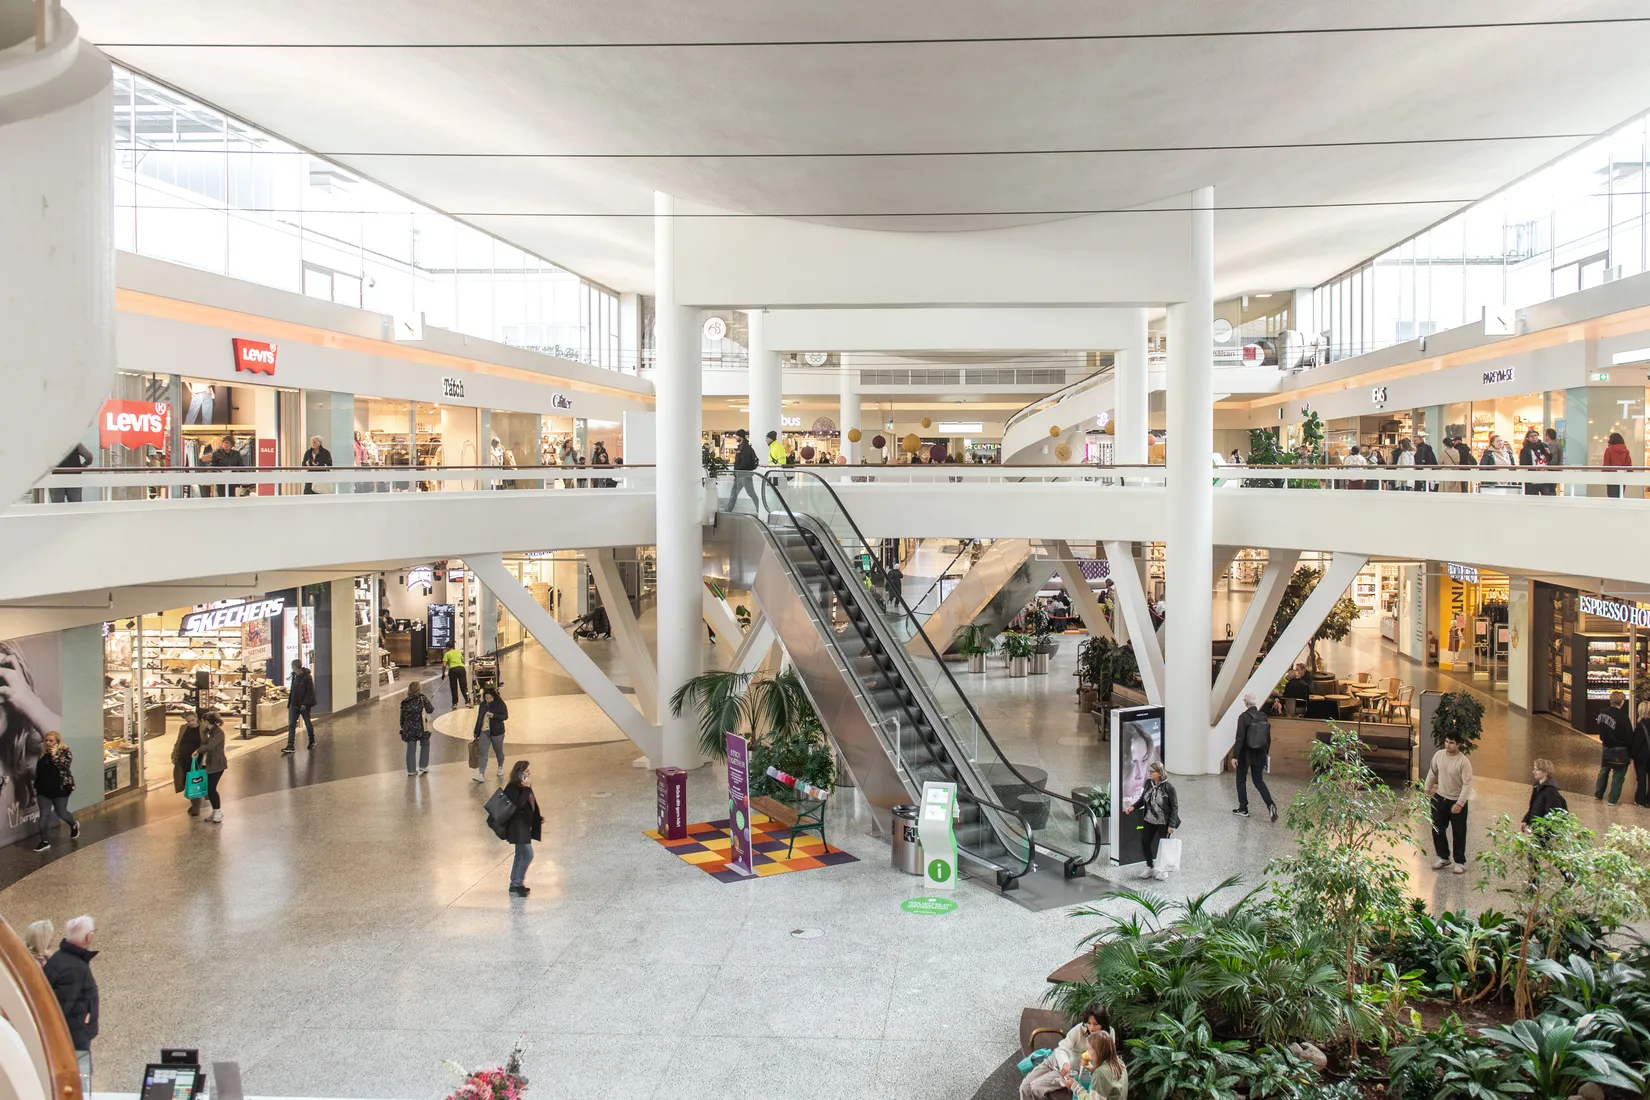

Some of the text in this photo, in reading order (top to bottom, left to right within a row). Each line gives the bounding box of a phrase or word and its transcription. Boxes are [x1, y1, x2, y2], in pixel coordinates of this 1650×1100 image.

[184, 597, 285, 636] SKECHERS
[1579, 595, 1629, 622] ESPRESSO
[247, 647, 267, 656] SKECHERS
